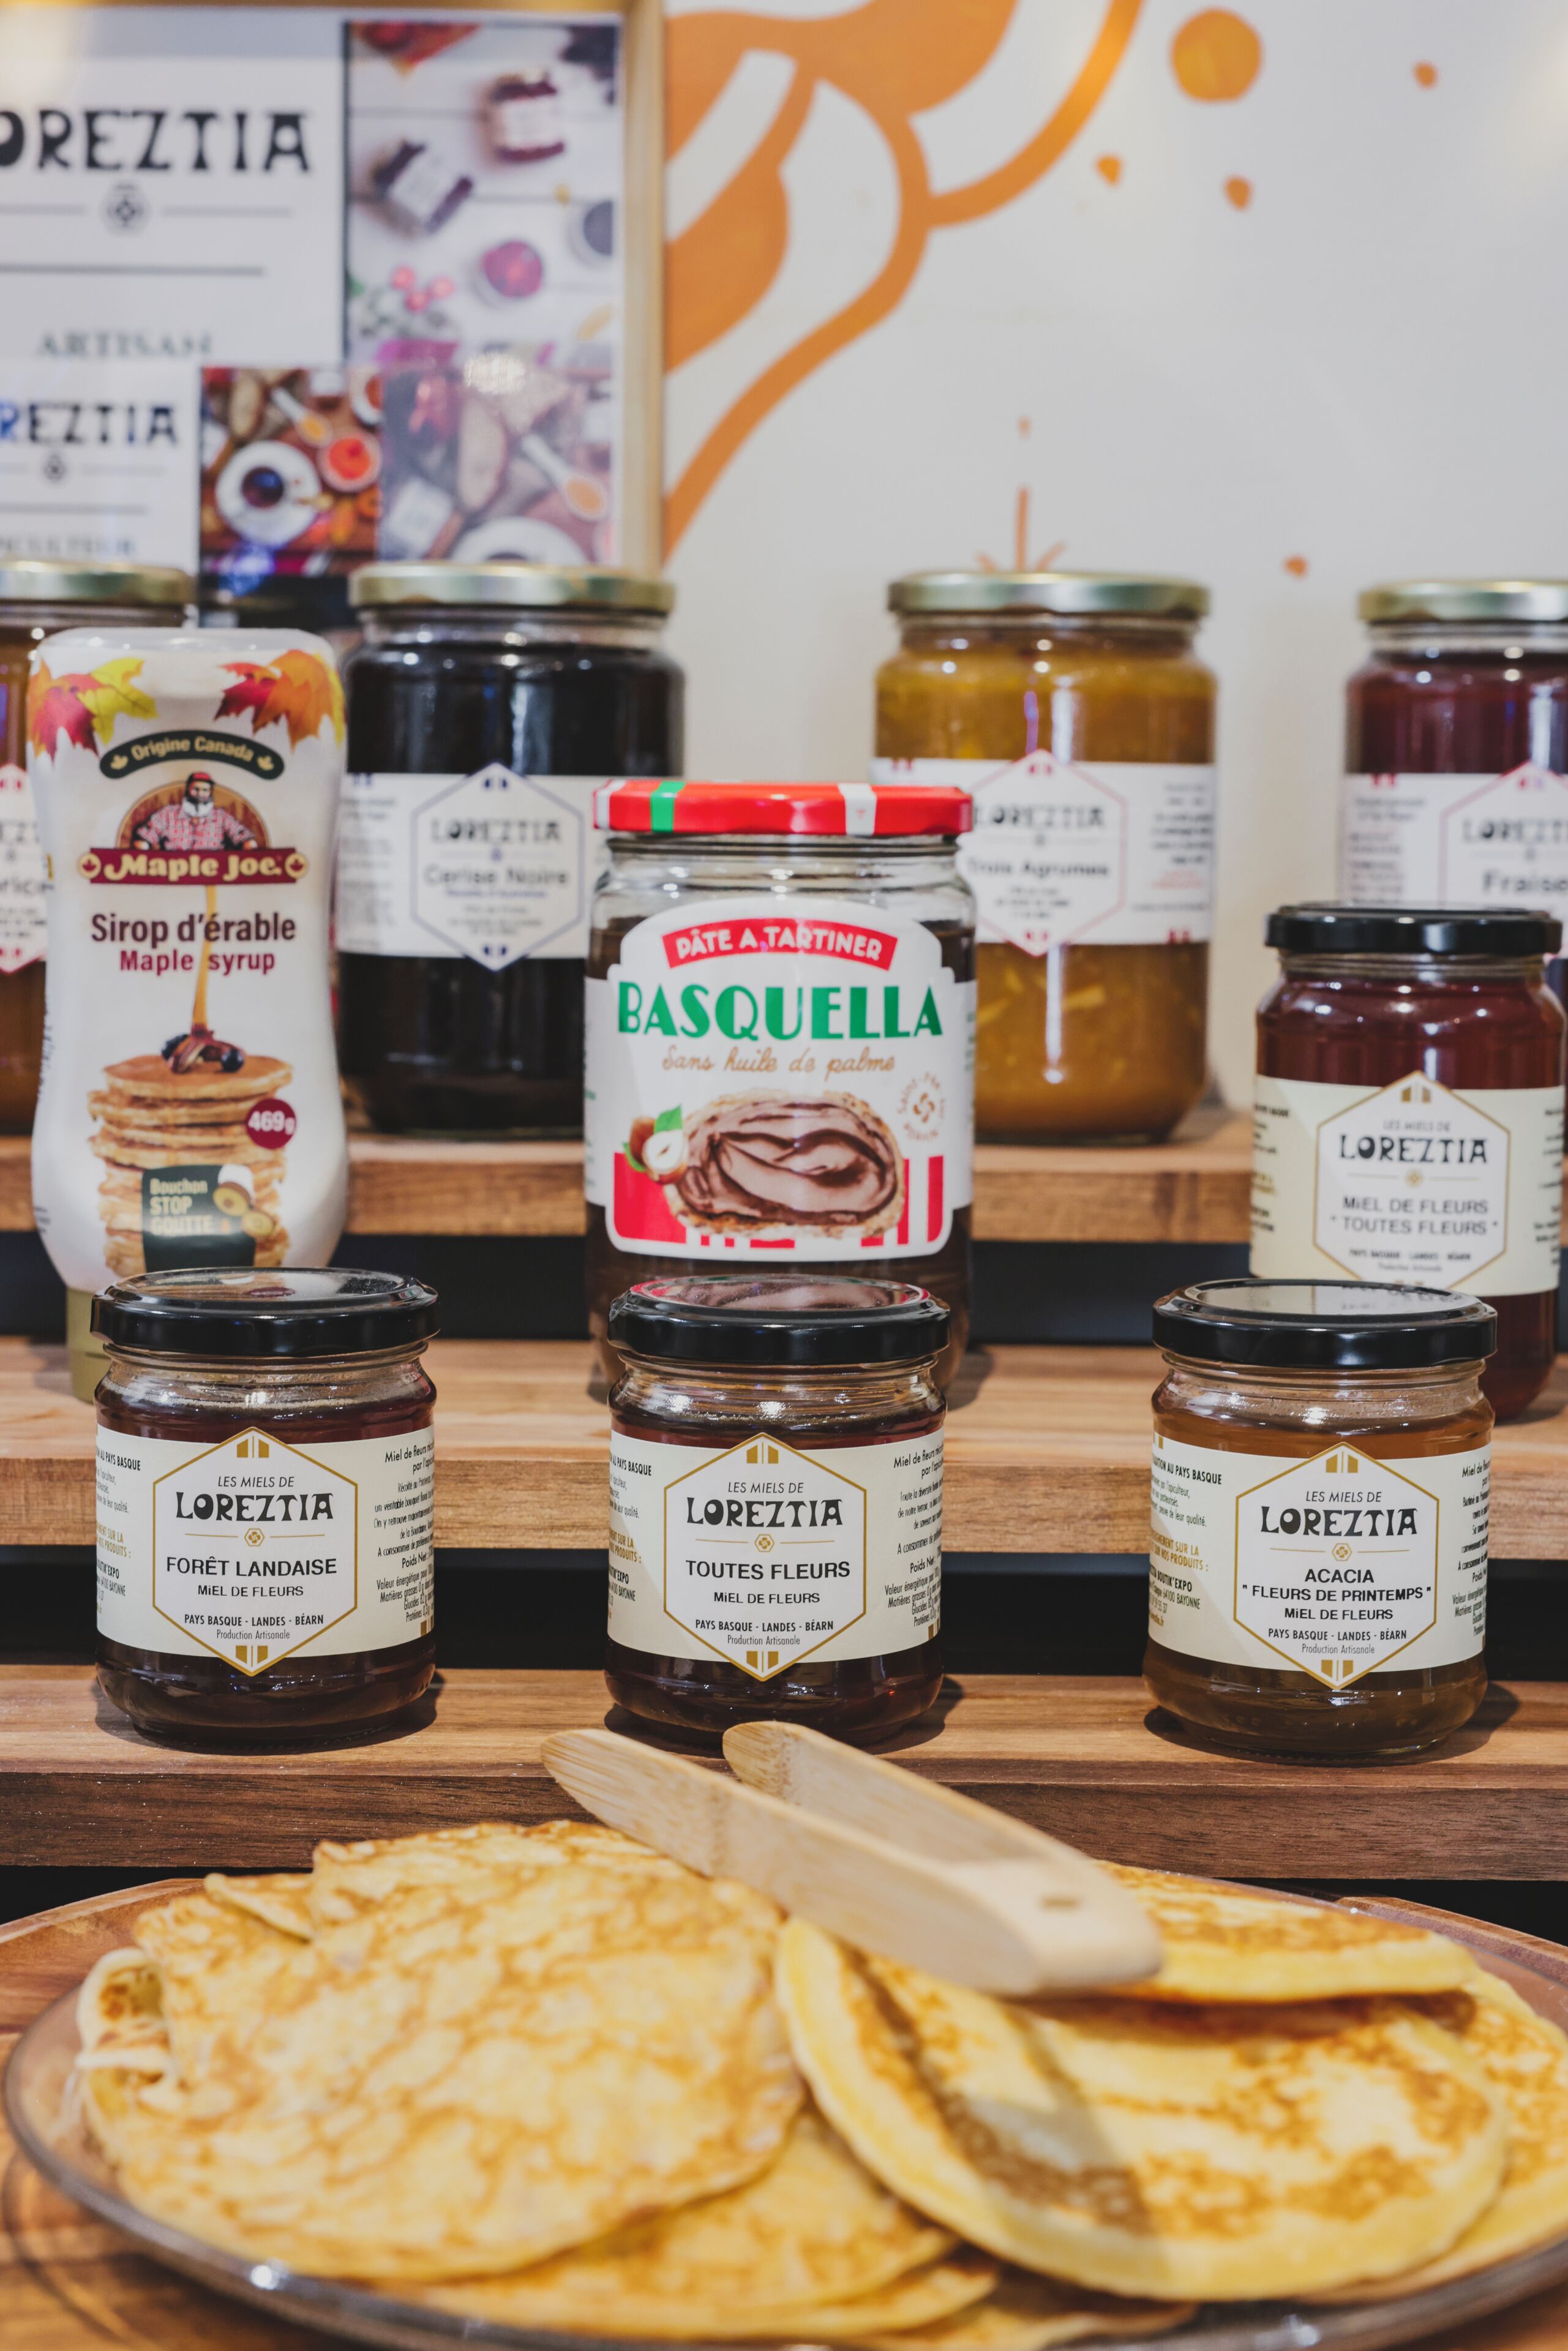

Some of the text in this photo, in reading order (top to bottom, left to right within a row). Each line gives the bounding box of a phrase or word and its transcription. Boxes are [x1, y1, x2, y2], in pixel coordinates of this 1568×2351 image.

[37, 332, 212, 358] ARTISAN
[130, 736, 253, 762] Origine Canada
[104, 853, 219, 882] Maple
[426, 866, 568, 883] Cerise Noire
[91, 912, 296, 950] Sirop d'érable
[676, 926, 882, 961] PÂTE A TARTINER
[120, 950, 276, 976] Maple syrup
[618, 981, 943, 1041] BASQUELLA
[662, 1044, 896, 1082] Sans huile de palme
[1383, 1120, 1451, 1131] LES MIELS DE
[1340, 1135, 1488, 1164] LOREZTIA
[150, 1179, 208, 1194] Bouchon
[149, 1197, 192, 1215] STOP
[1390, 1198, 1413, 1214] DE
[1420, 1199, 1488, 1215] FLEURS
[1343, 1216, 1487, 1235] TOUTES FLEURS
[105, 1452, 116, 1465] PAYS
[117, 1456, 140, 1471] BASQUE
[385, 1448, 402, 1463] Miel
[404, 1447, 412, 1459] de
[413, 1445, 426, 1457] fleurs
[894, 1453, 910, 1468] Miel
[913, 1452, 920, 1464] de
[923, 1450, 934, 1461] fleurs
[413, 1462, 422, 1474] par
[617, 1457, 651, 1475] PAYS BASQUE
[921, 1466, 931, 1479] par
[1167, 1463, 1221, 1485] AU PAYS BASQUE
[1462, 1463, 1476, 1478] Miel
[218, 1476, 294, 1488] LES MIELS DE
[729, 1482, 804, 1493] LES MIELS DE
[1306, 1491, 1382, 1503] LES MIELS DE
[176, 1491, 334, 1521] LOREZTIA
[687, 1497, 842, 1528] LOREZTIA
[373, 1518, 381, 1528] On
[1176, 1509, 1206, 1526] leur qualité.
[1261, 1506, 1417, 1537] LOREZTIA
[118, 1532, 123, 1543] LA
[628, 1537, 634, 1548] LA
[105, 1540, 127, 1557] PRODUITS
[615, 1546, 637, 1562] PRODUITS
[1176, 1542, 1199, 1556] SUR LA
[167, 1556, 337, 1577] FORÊT LANDAISE
[402, 1556, 417, 1569] Poids
[910, 1560, 925, 1573] Poids
[1171, 1553, 1203, 1570] PRODUITS
[686, 1560, 850, 1580] TOUTES FLEURS
[1305, 1569, 1374, 1583] ACACIA
[109, 1580, 126, 1597] BAYONNE
[377, 1572, 419, 1590] Valeur énergétique
[885, 1583, 902, 1595] Valeur
[231, 1586, 248, 1597] DE
[253, 1586, 304, 1597] FLEURS
[380, 1591, 402, 1603] Matières
[618, 1586, 636, 1601] BAYONNE
[748, 1594, 765, 1604] DE
[769, 1593, 820, 1604] FLEURS
[1253, 1585, 1423, 1601] FLEURS DE PRINTEMPS
[888, 1595, 910, 1608] Matières
[1177, 1593, 1200, 1609] BAYONNE
[184, 1613, 323, 1626] PAYS BASQUE LANDES BÉARN
[1320, 1610, 1338, 1620] DE
[1342, 1609, 1393, 1620] FLEURS
[696, 1619, 833, 1632] PAYS BASQUE LANDES BÉARN
[217, 1629, 290, 1640] Production Artisanale
[727, 1635, 800, 1645] Production Artisanale
[1269, 1628, 1406, 1641] PAYS BASQUE LANDES BÉARN
[1302, 1643, 1375, 1654] Production Artisanale
